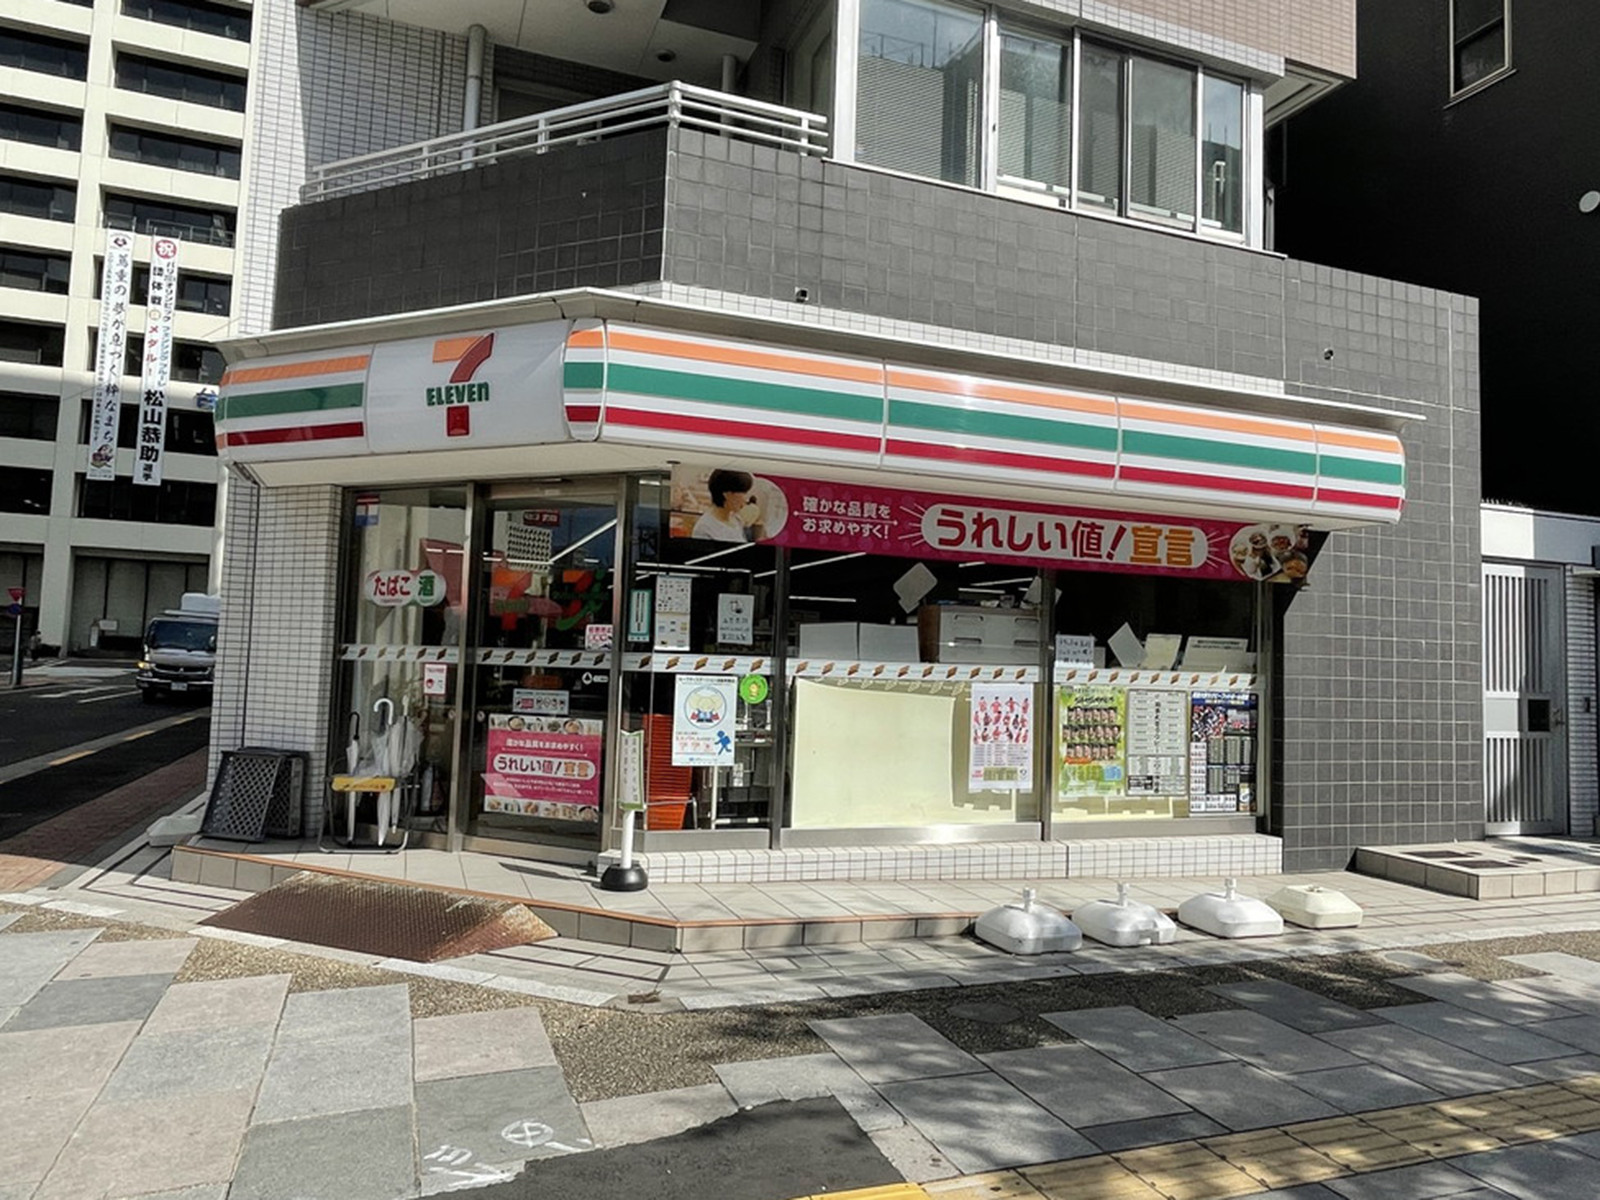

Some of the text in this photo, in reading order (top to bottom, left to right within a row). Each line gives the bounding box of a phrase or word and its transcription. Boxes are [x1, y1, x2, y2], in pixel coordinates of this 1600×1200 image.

[158, 242, 174, 258] 祝
[802, 496, 892, 519] 確かな品質を
[802, 518, 889, 540] お求めやすく!
[936, 508, 1196, 567] うれしい値!宣言
[373, 575, 411, 597] たばこ
[418, 575, 435, 597] 酒
[498, 756, 590, 778] うれしい値!宣言
